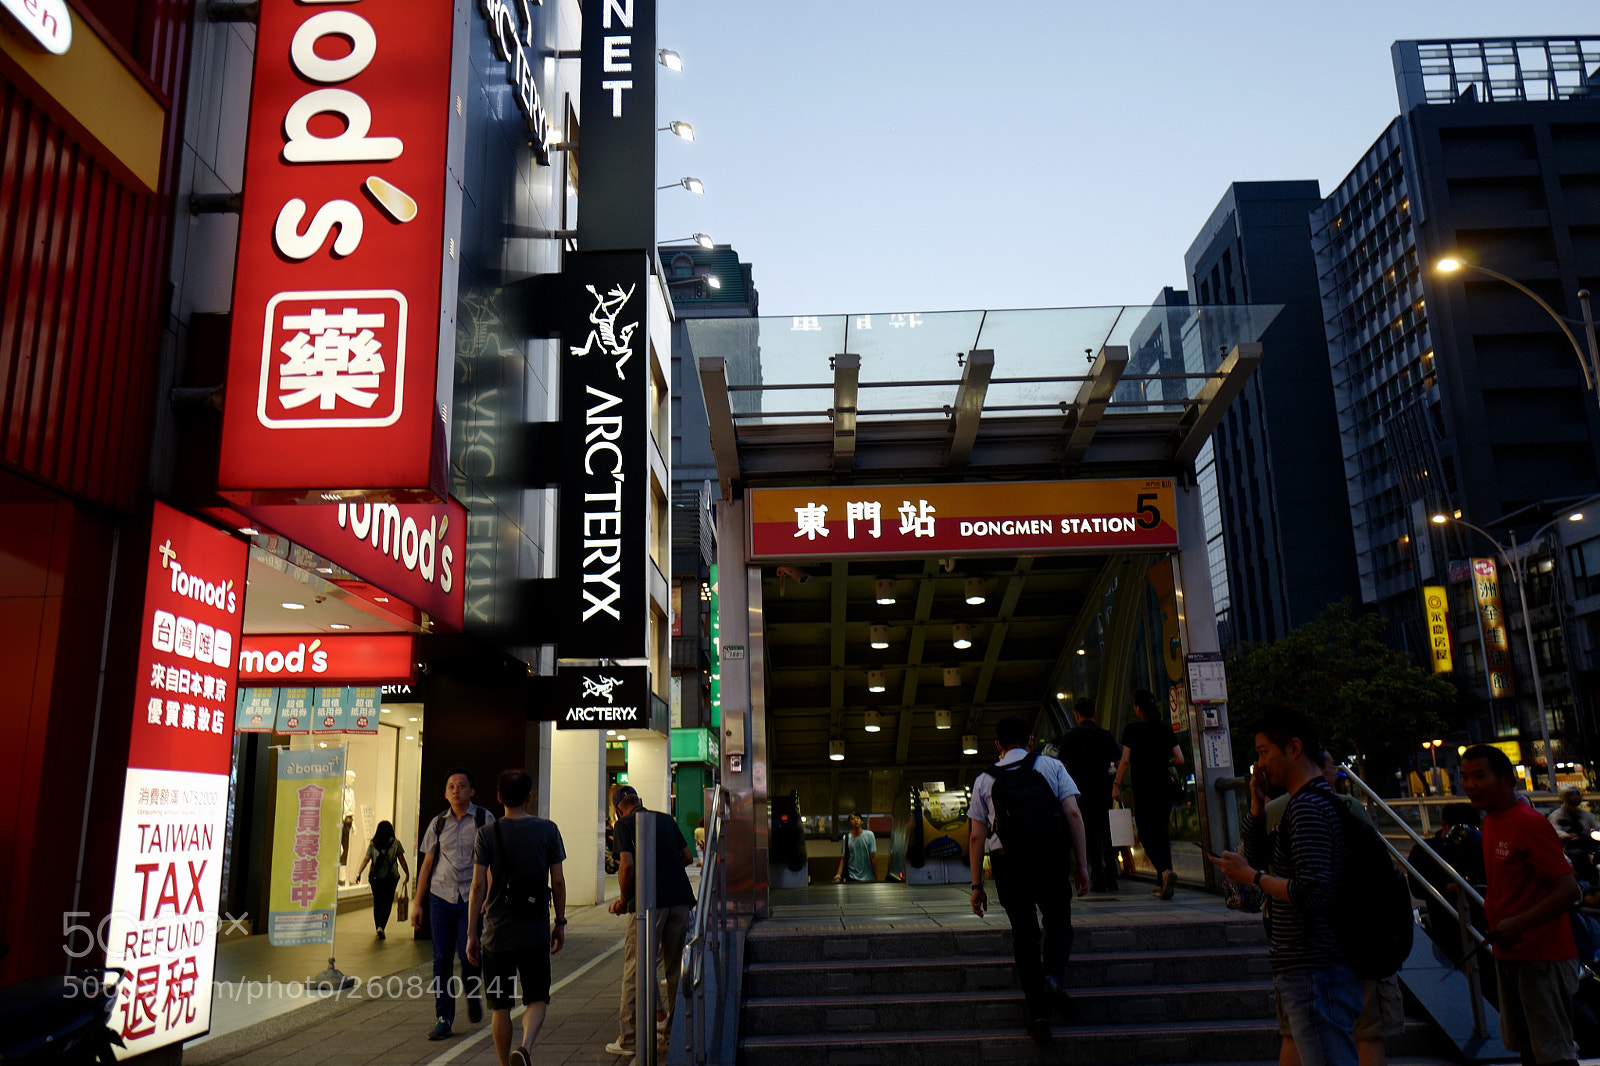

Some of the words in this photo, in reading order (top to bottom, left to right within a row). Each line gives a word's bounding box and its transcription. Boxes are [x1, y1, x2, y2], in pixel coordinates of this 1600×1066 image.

[602, 0, 634, 118] NET
[275, 0, 418, 259] od's
[279, 307, 386, 411] 藥
[582, 384, 623, 622] ARC'TERYX
[793, 499, 936, 541] 東門站
[1136, 493, 1161, 529] 5
[959, 518, 1053, 537] DONGMEN
[1061, 516, 1136, 534] STATION
[169, 560, 237, 614] Tomod's
[156, 615, 230, 659] 台灣唯一
[150, 662, 227, 702] 來自日本東京
[566, 706, 637, 722] ARC'TERYX
[137, 823, 214, 854] TAIWAN
[134, 859, 208, 921] TAX
[123, 920, 205, 962] REFUND
